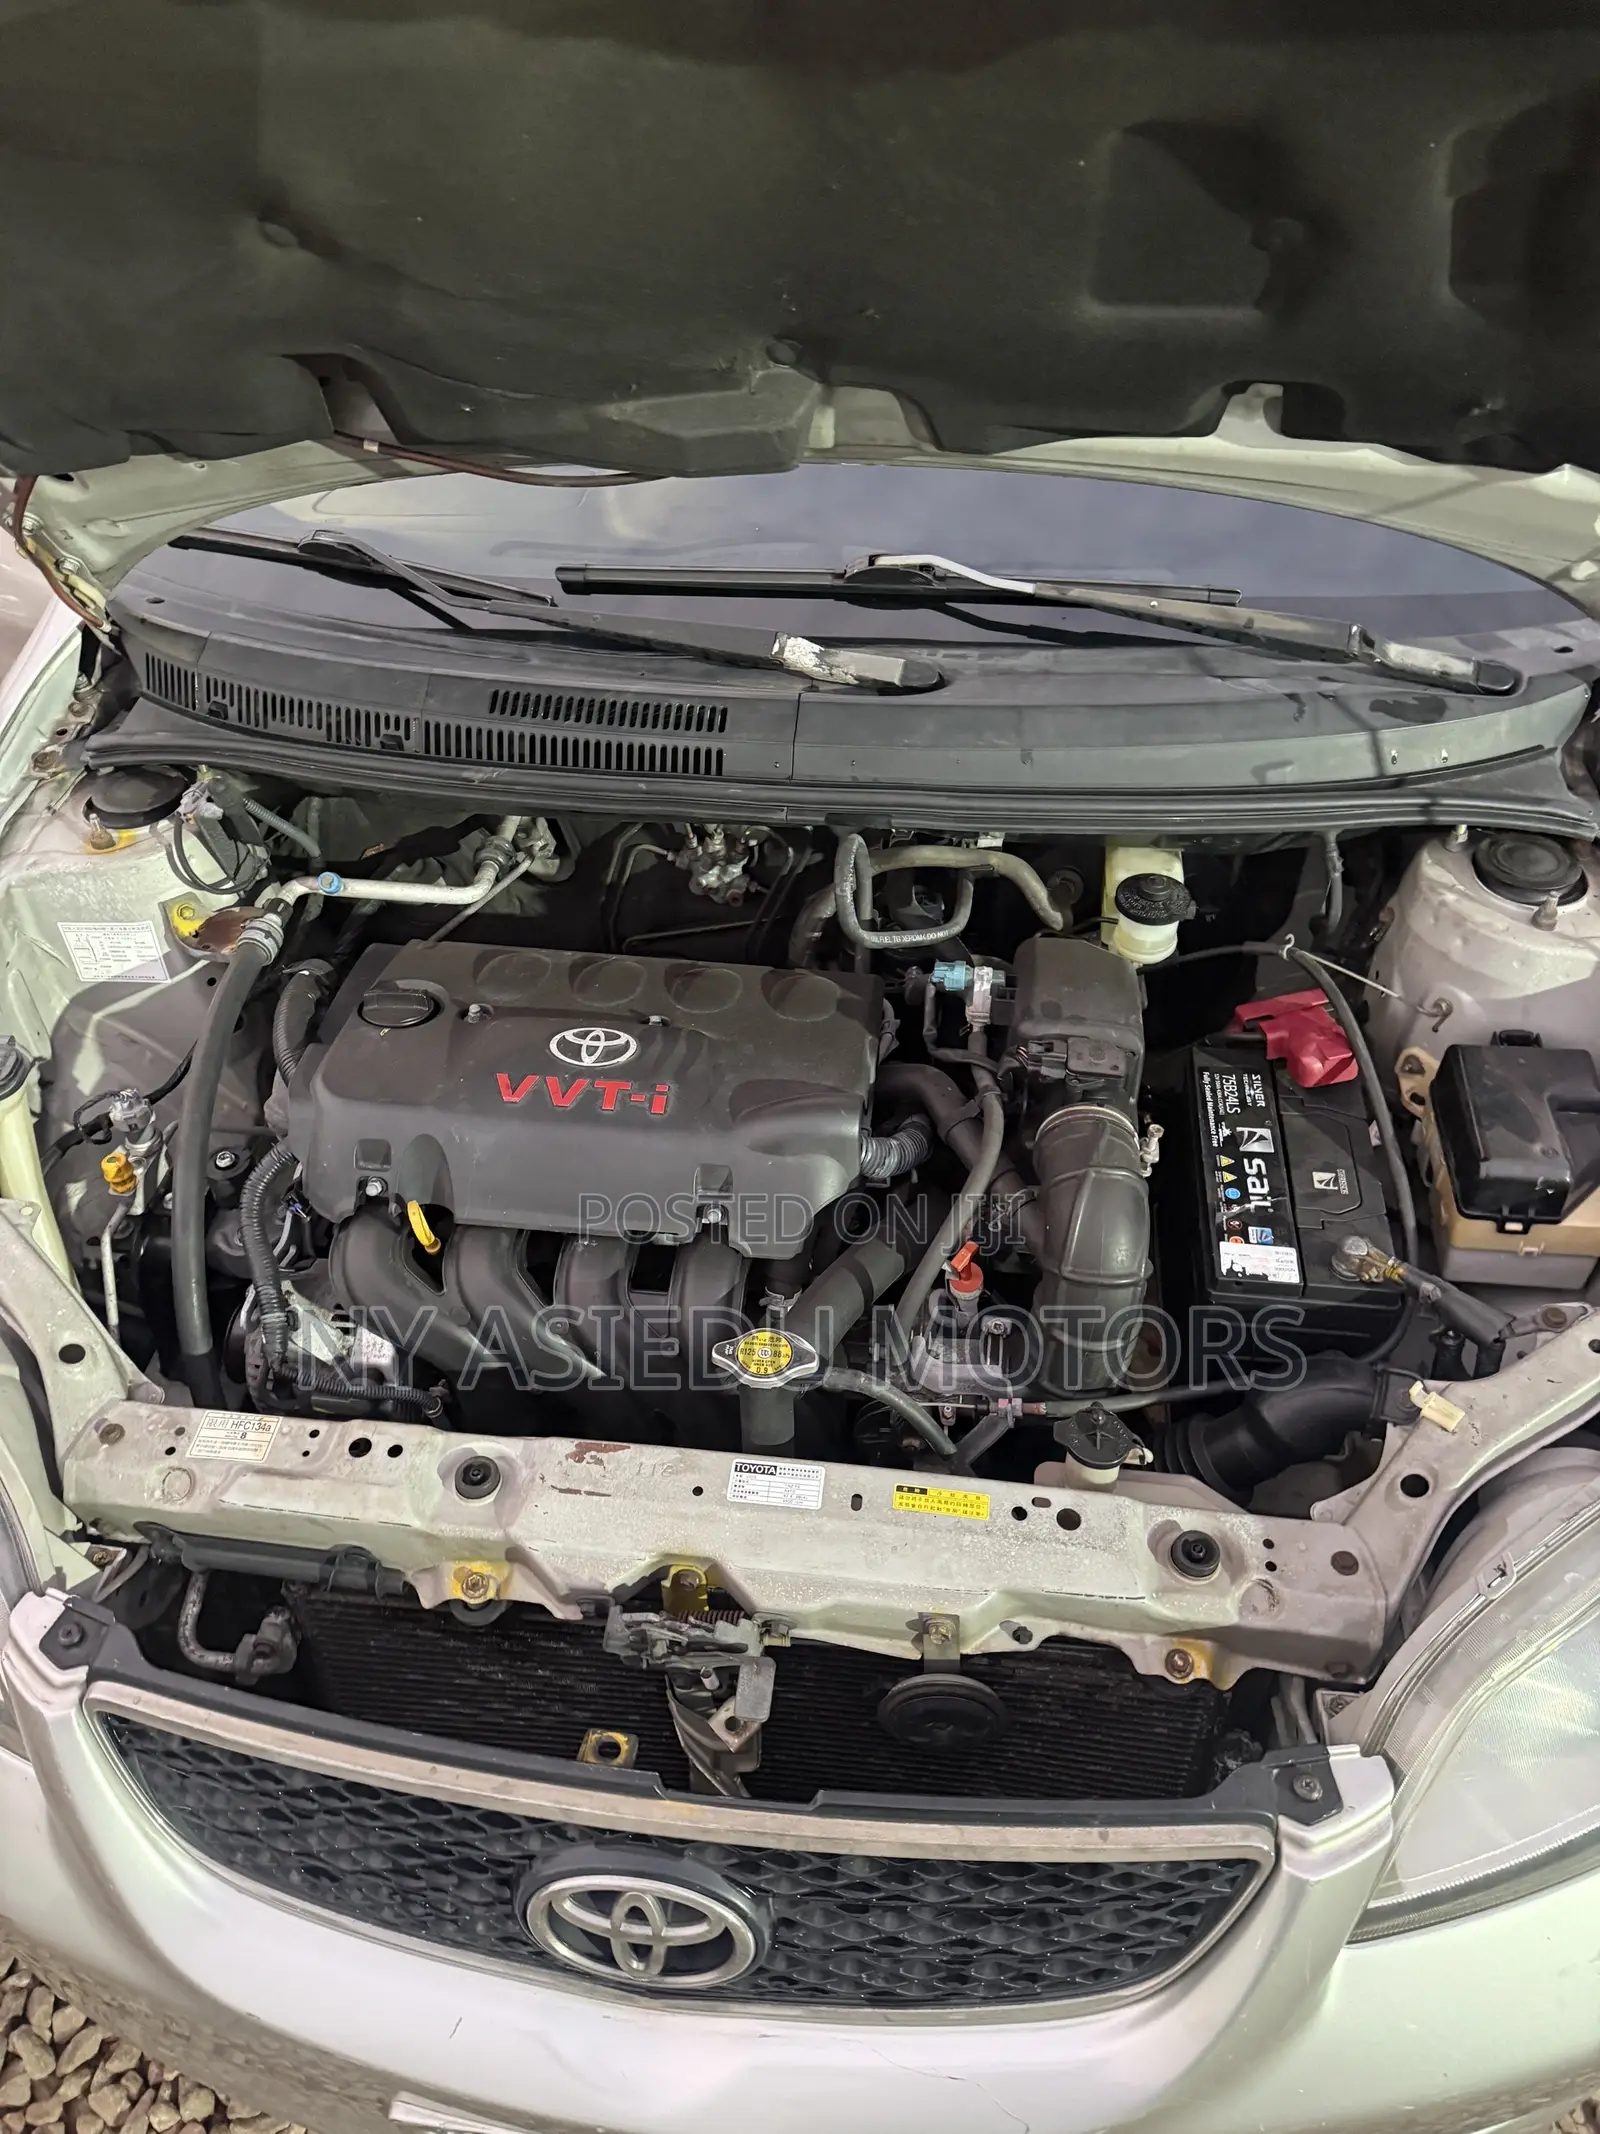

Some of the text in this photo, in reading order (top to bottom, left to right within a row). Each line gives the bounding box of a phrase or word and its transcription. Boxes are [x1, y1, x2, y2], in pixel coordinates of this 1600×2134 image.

[1202, 1071, 1210, 1084] Fully
[496, 1073, 670, 1115] VVT-i
[1204, 1084, 1214, 1101] Sealed
[1222, 1074, 1241, 1114] 75B24LS
[1252, 1073, 1266, 1107] SILVER
[1207, 1101, 1217, 1134] Maintenance
[1211, 1135, 1219, 1147] Free
[1243, 1157, 1272, 1212] sail
[756, 1366, 768, 1374] 0.9
[230, 1420, 272, 1432] HFC134a
[736, 1463, 777, 1475] TOYOTA
